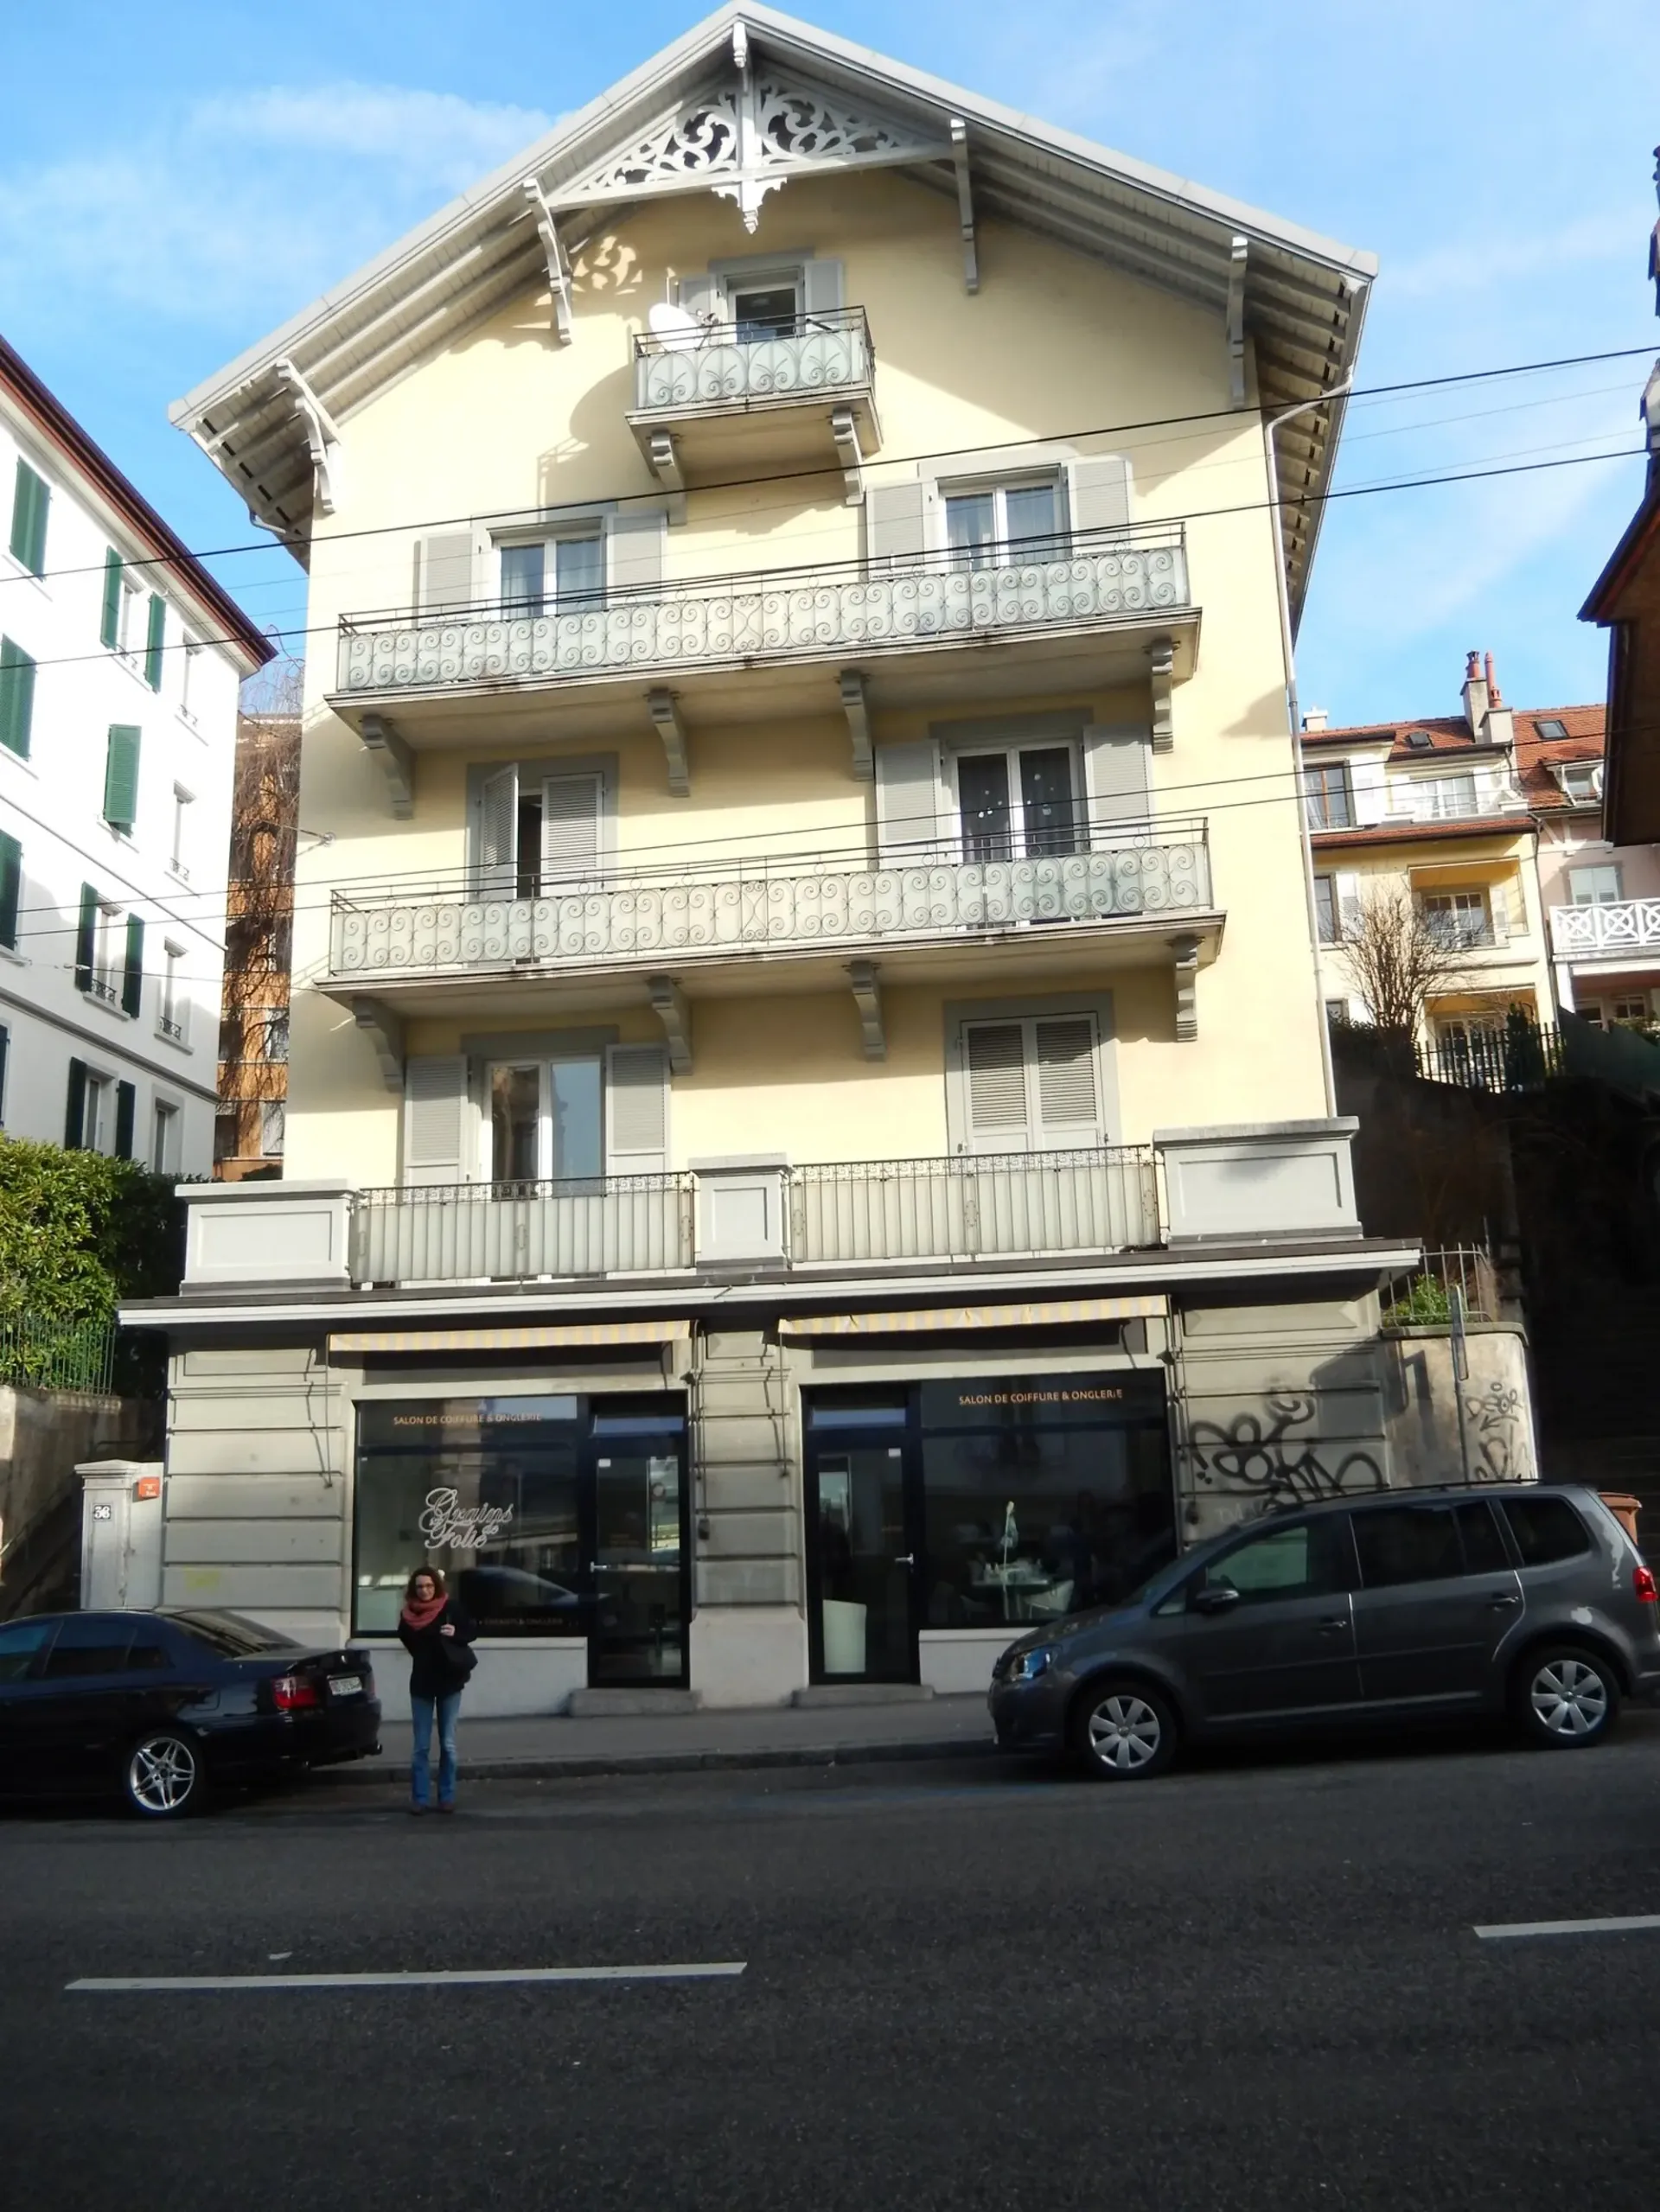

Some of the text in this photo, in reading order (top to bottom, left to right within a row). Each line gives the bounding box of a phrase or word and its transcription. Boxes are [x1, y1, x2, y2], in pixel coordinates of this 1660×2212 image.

[959, 1389, 1123, 1405] SALON DE COIFFURE & ONGLERIE
[393, 1416, 424, 1425] SALON
[425, 1415, 437, 1425] DE
[440, 1414, 484, 1424] COIFFURE
[420, 1487, 514, 1528] Grains
[424, 1520, 488, 1549] Folie
